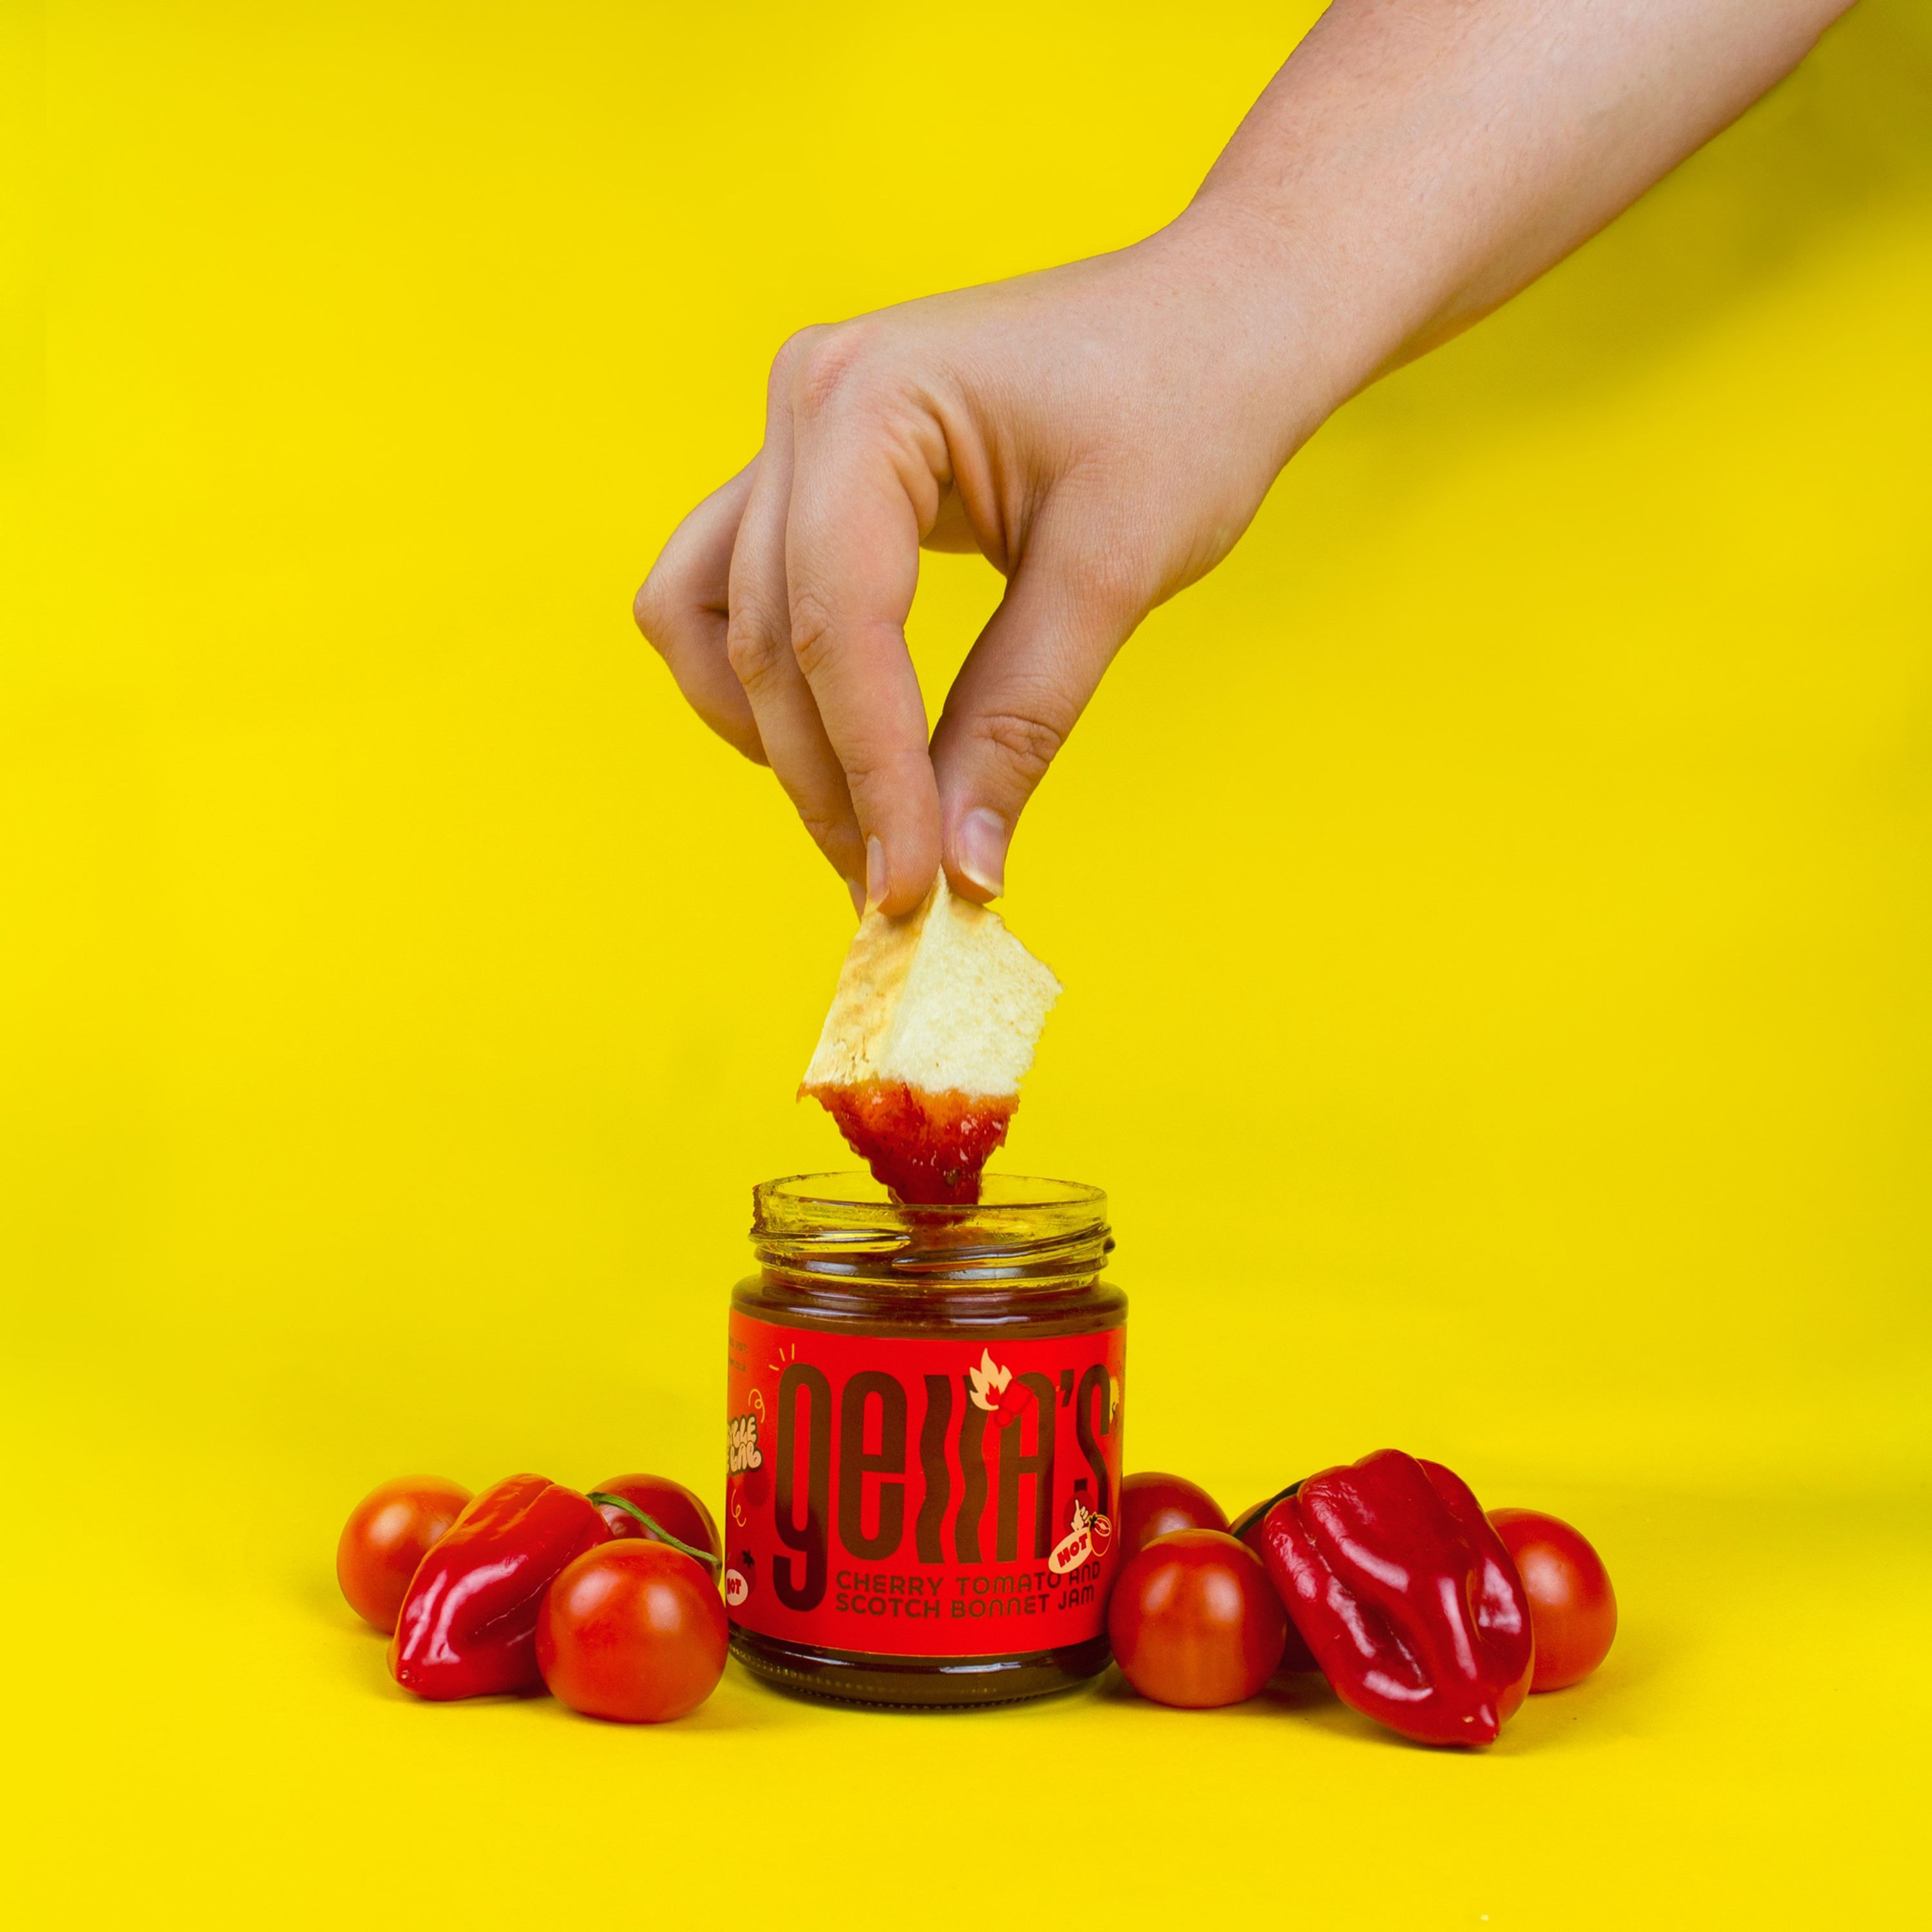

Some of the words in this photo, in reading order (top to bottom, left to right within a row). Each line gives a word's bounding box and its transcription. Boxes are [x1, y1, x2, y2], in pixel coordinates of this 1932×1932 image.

[1057, 1533, 1088, 1568] HOT
[836, 1570, 943, 1596] CHERRY
[956, 1570, 1061, 1596] TOMATO
[1069, 1560, 1100, 1586] AND
[835, 1593, 940, 1619] SCOTCH
[951, 1593, 1049, 1619] BONNET
[1057, 1584, 1094, 1610] JAM
